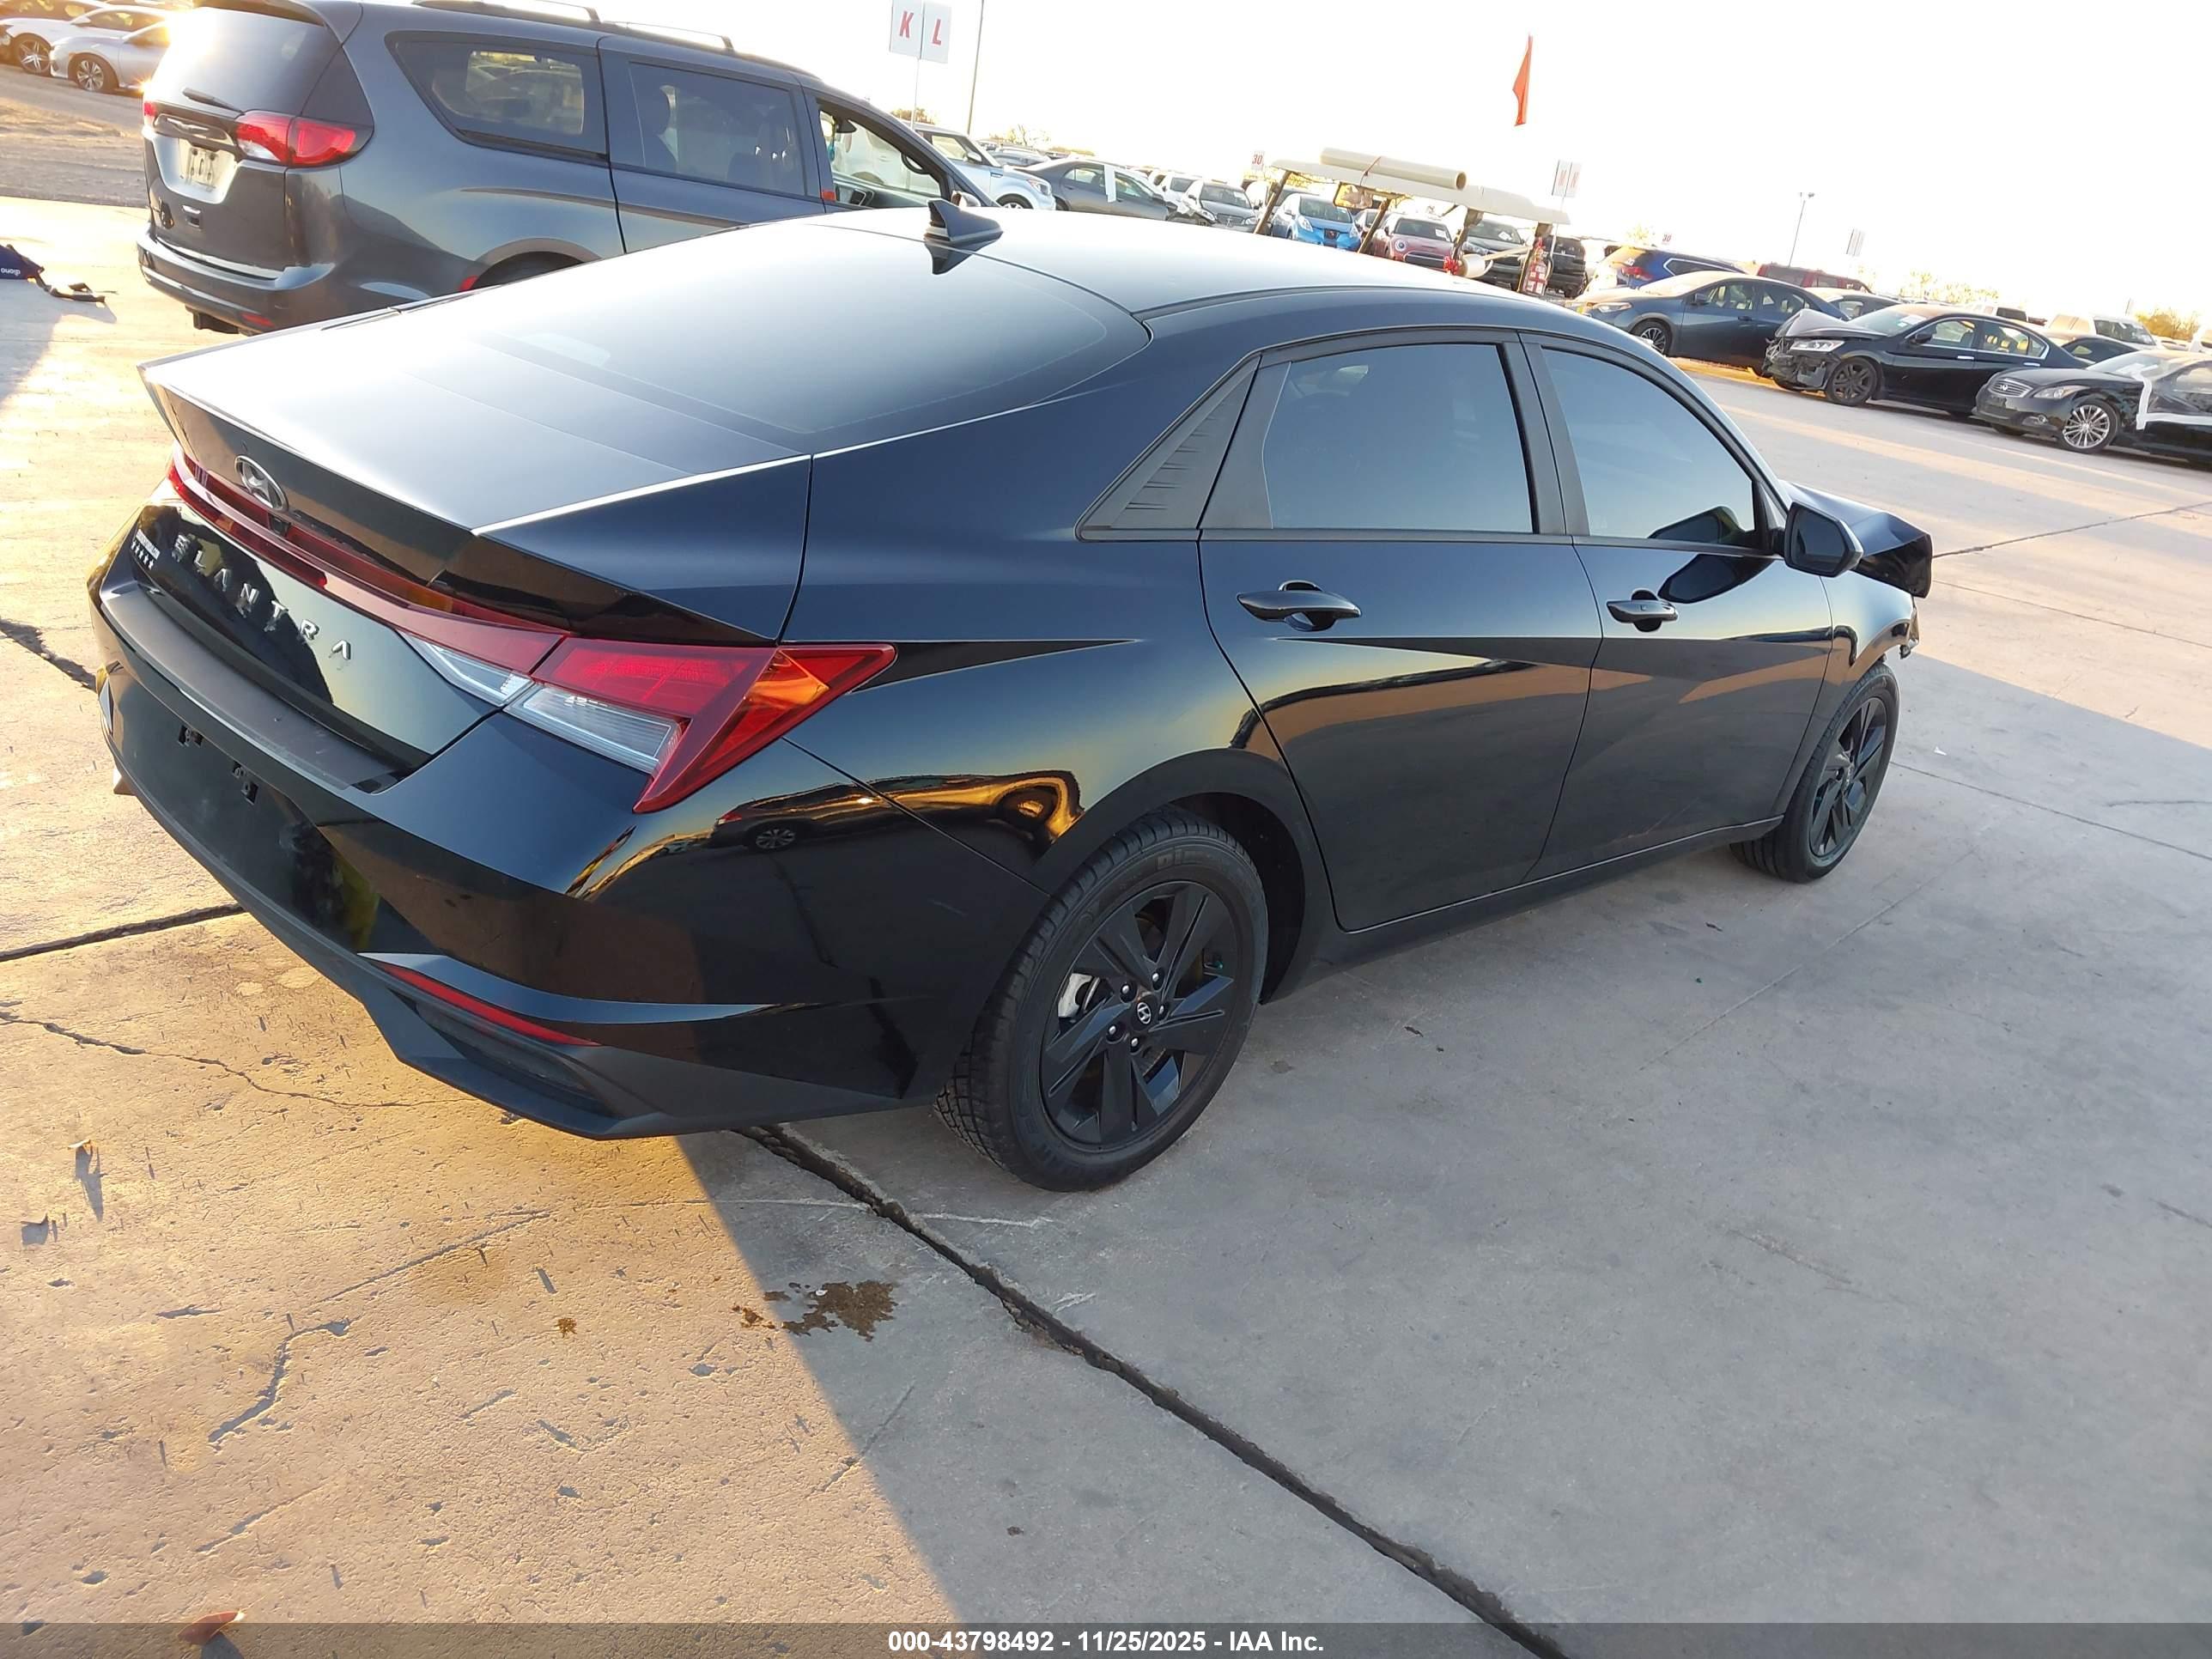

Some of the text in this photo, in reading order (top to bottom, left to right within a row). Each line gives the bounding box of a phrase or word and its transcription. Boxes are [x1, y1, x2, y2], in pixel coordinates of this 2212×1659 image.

[899, 10, 914, 39] K
[932, 18, 941, 46] L
[1251, 154, 1263, 165] 30
[173, 534, 351, 660] ELANTRA
